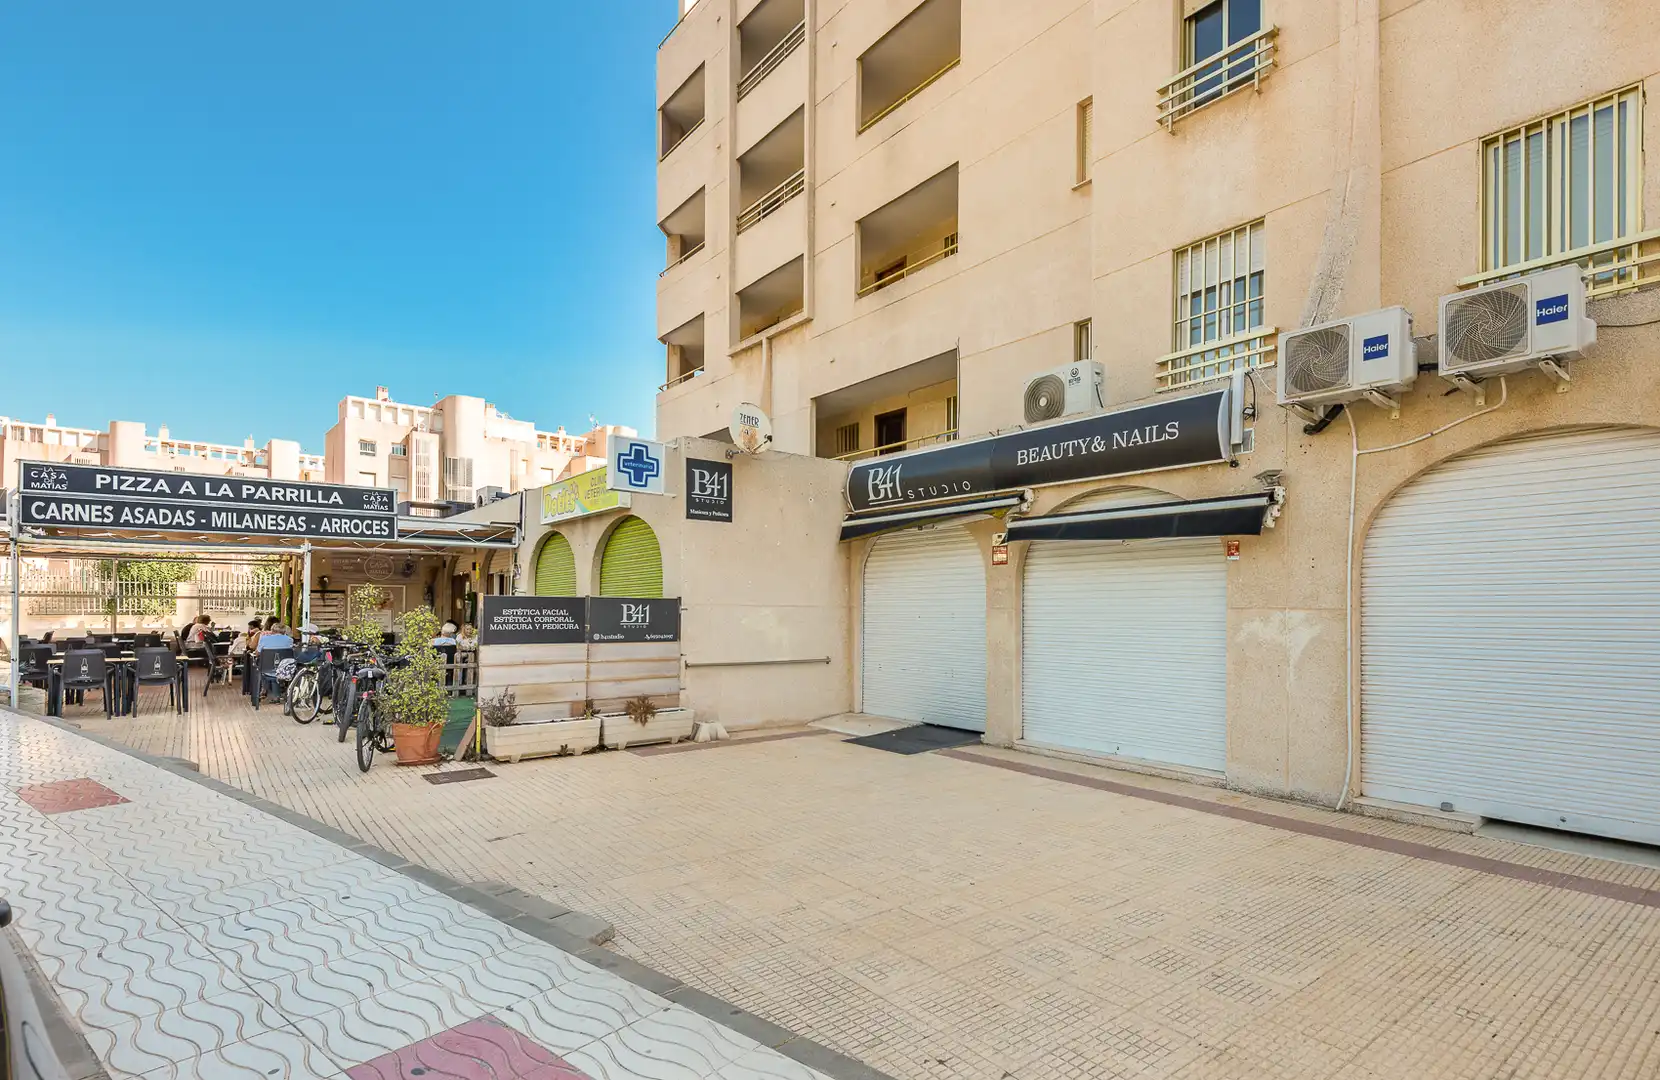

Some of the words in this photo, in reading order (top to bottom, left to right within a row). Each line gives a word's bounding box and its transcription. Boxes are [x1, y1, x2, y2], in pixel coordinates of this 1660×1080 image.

[1536, 304, 1568, 317] Haier
[1363, 343, 1388, 354] Haier
[1112, 421, 1179, 450] NAILS
[31, 471, 67, 480] CASA
[691, 468, 727, 498] B41
[868, 463, 903, 501] B41
[95, 474, 171, 494] PIZZA
[178, 480, 197, 495] A
[205, 482, 235, 498] LA
[242, 485, 344, 505] PARRILLA
[31, 501, 114, 523] CARNES
[119, 507, 195, 527] ASADAS
[211, 511, 307, 532] MILANESAS
[320, 518, 390, 536] ARROCES
[502, 608, 540, 616] ESTÉTICA
[620, 603, 650, 623] B41
